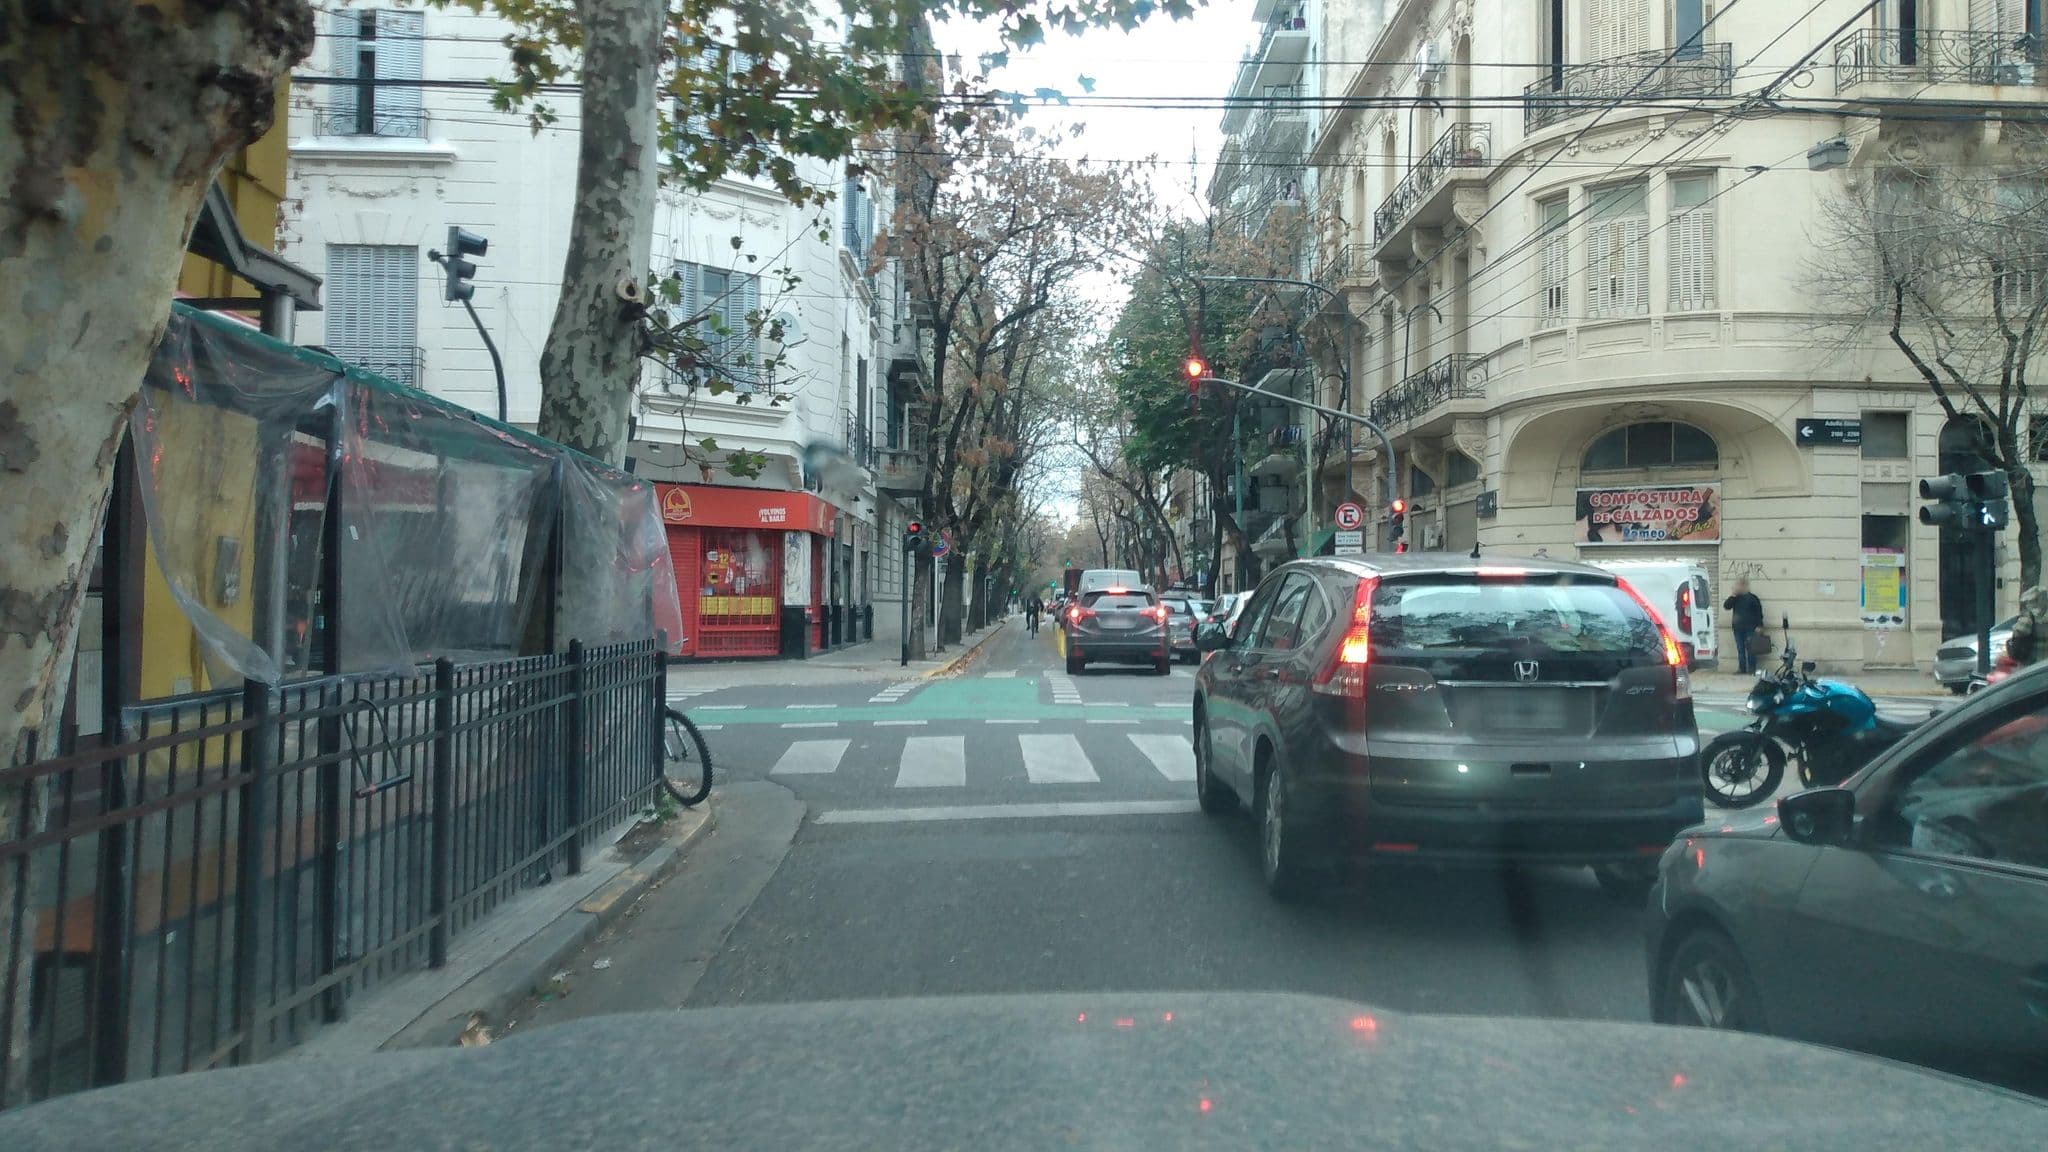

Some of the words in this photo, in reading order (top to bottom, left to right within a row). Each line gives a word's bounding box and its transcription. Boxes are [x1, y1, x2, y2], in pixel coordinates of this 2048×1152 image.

[1590, 490, 1703, 506] COMPOSTURA
[1593, 513, 1610, 523] DE
[1612, 508, 1699, 522] CALZADOS
[1623, 527, 1666, 538] Romeo
